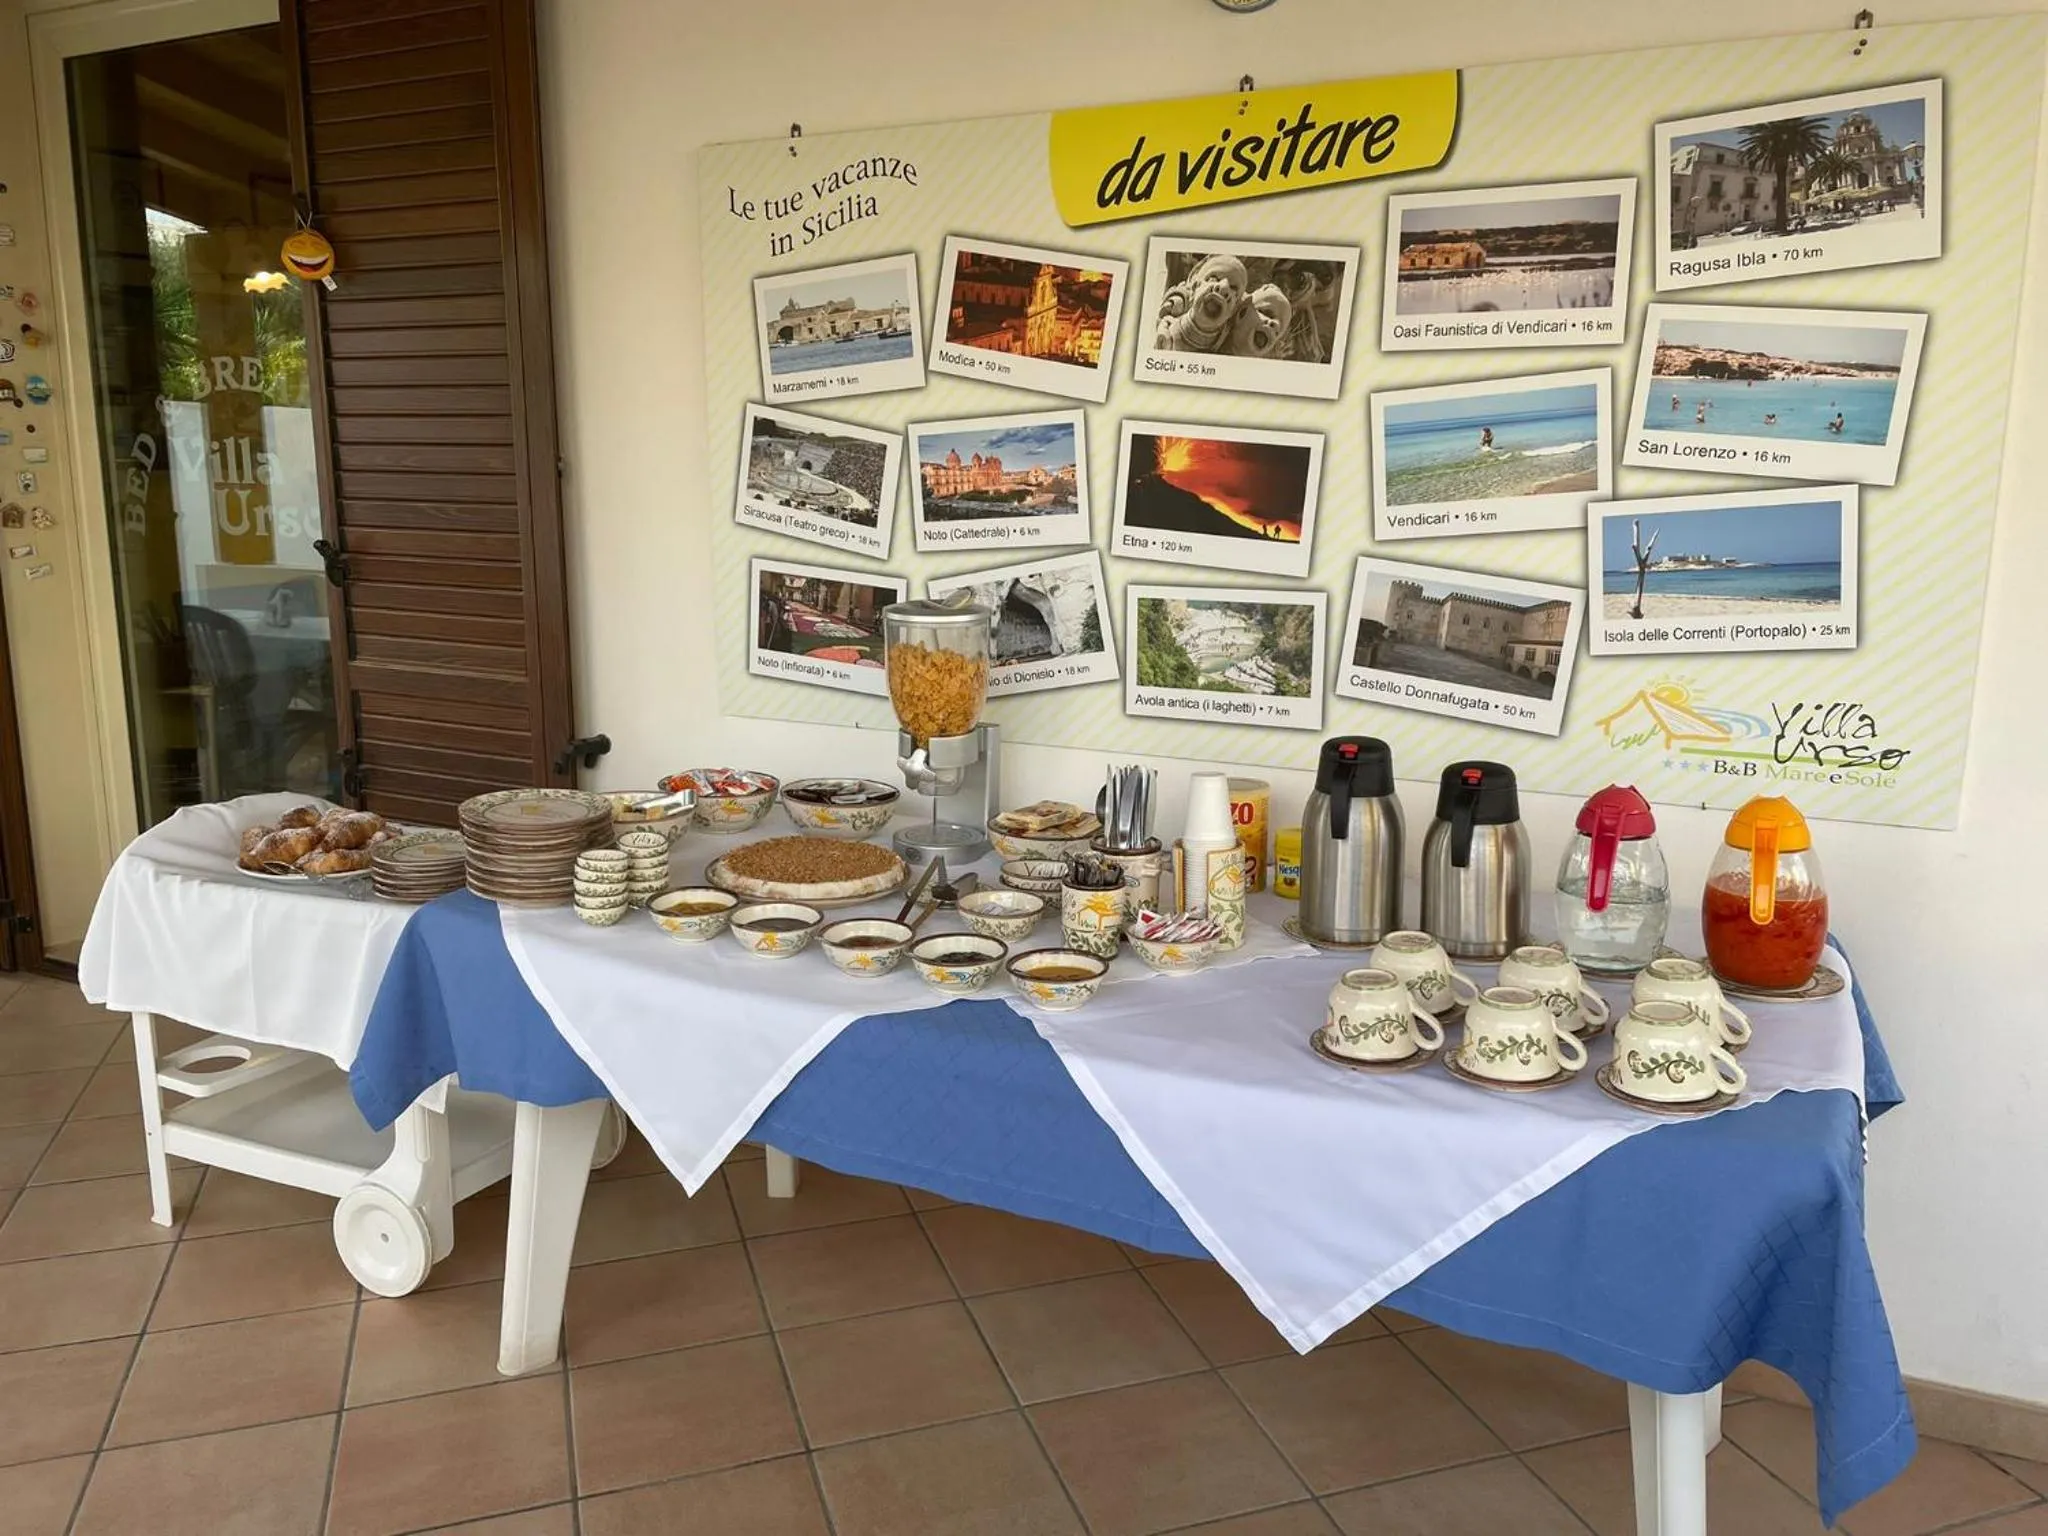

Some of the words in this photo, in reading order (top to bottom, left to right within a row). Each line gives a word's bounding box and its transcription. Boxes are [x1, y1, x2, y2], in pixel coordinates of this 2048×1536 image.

[1096, 135, 1166, 208] da
[1177, 103, 1399, 195] visitare
[728, 186, 755, 221] Le
[764, 190, 804, 221] tue
[811, 156, 918, 200] vacanze
[770, 233, 794, 257] in
[802, 194, 878, 245] Sicilia
[1670, 259, 1731, 277] Ragusa
[1737, 251, 1766, 268] Ibla
[1783, 250, 1799, 261] 70
[1803, 247, 1823, 259] km
[1393, 324, 1421, 338] Oasi
[1424, 321, 1488, 337] Faunistica
[1491, 319, 1503, 334] di
[1506, 318, 1567, 334] Vendicari
[1581, 320, 1594, 331] 16
[1597, 320, 1612, 331] km
[938, 350, 976, 368] Modica
[985, 361, 996, 372] 50
[997, 364, 1011, 374] km
[1145, 357, 1176, 372] Scicli
[1187, 364, 1199, 374] 55
[1201, 366, 1216, 375] km
[773, 376, 827, 394] Marzamemi
[847, 376, 859, 384] km
[167, 436, 283, 485] Villa
[1638, 439, 1668, 455] San
[1673, 442, 1737, 460] Lorenzo
[1754, 450, 1768, 462] 16
[1771, 452, 1791, 464] km
[124, 433, 157, 536] BED
[744, 504, 783, 523] Siracusa
[784, 516, 819, 532] (Teatro
[819, 525, 850, 541] greco)
[869, 538, 881, 548] km
[1387, 511, 1451, 528] Vendicari
[1464, 512, 1478, 522] 16
[1480, 511, 1498, 521] km
[924, 530, 947, 541] Noto
[950, 526, 1010, 542] (Cattedrale)
[1027, 527, 1041, 536] km
[1122, 534, 1149, 548] Etna
[1160, 540, 1177, 552] 120
[1178, 543, 1193, 553] km
[1604, 629, 1635, 643] Isola
[1638, 627, 1670, 642] delle
[1673, 626, 1727, 641] Correnti
[1730, 623, 1808, 642] (Portopalo)
[1819, 624, 1834, 636] 25
[1835, 624, 1851, 635] km
[757, 656, 779, 669] Noto
[839, 671, 851, 680] km
[1002, 673, 1013, 686] di
[1013, 667, 1055, 684] Dionisio
[1077, 665, 1090, 674] km
[1135, 694, 1166, 707] Avola
[1167, 697, 1200, 710] antica
[1211, 702, 1257, 717] laghetti)
[1267, 706, 1274, 715] 7
[1275, 708, 1291, 716] km
[1350, 675, 1402, 695] Castello
[1405, 684, 1490, 711] Donnafugata
[1502, 704, 1518, 716] 50
[1519, 708, 1536, 720] km
[1771, 701, 1878, 740] Villa
[1773, 734, 1911, 771] Urso
[1714, 760, 1758, 777] B&B
